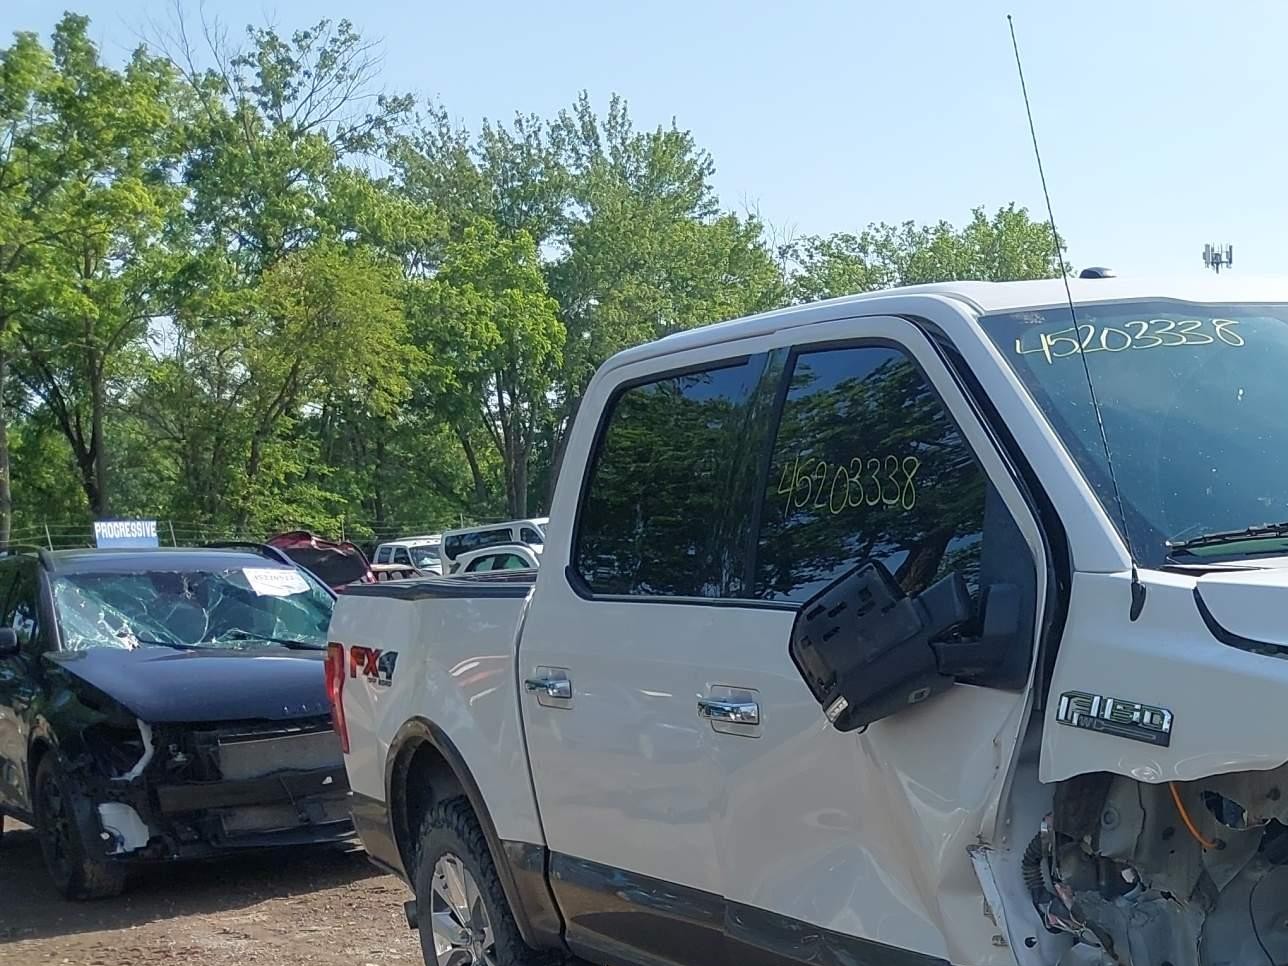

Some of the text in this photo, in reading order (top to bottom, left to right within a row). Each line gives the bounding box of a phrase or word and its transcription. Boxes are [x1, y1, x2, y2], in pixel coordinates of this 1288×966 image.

[1016, 319, 1244, 364] 45203338
[778, 455, 920, 517] 45203338
[94, 520, 157, 539] PROGRESSIVE
[350, 645, 398, 680] FX4
